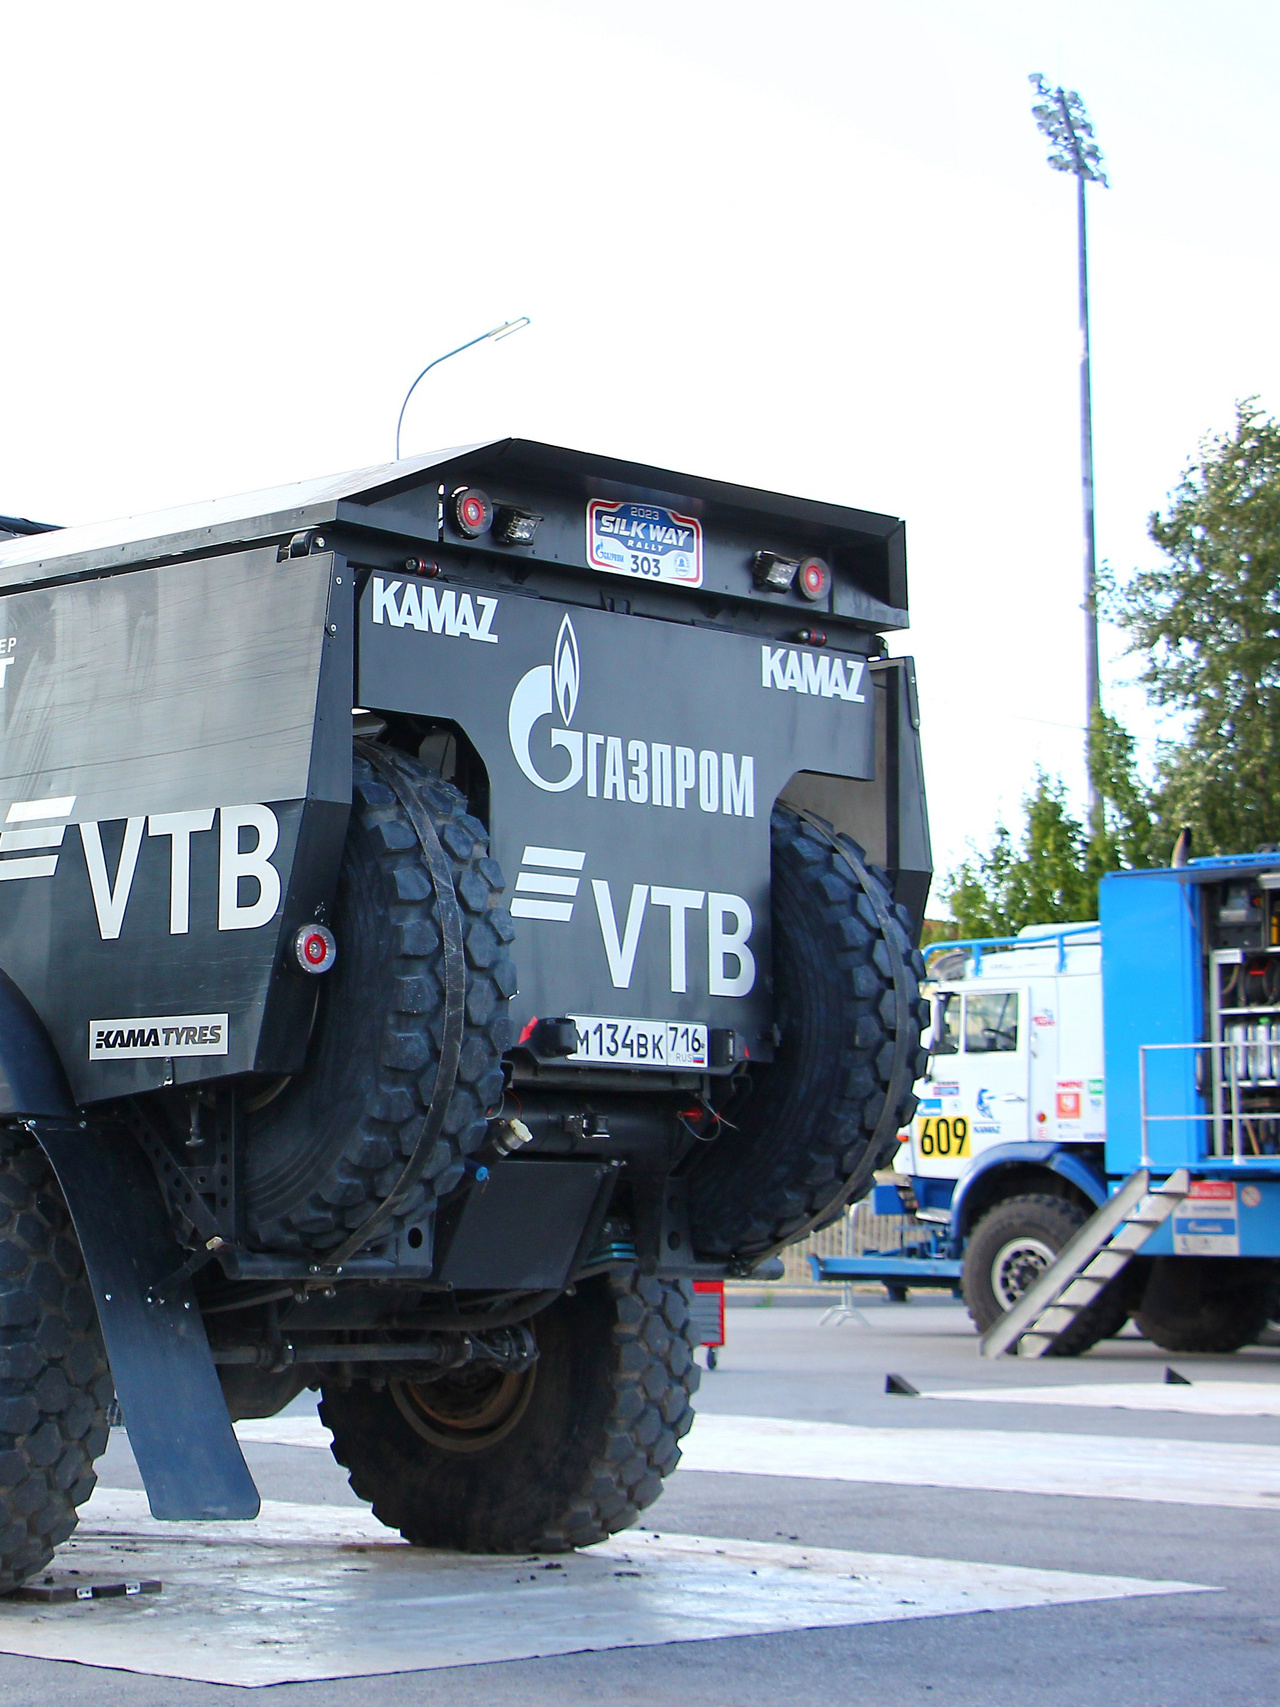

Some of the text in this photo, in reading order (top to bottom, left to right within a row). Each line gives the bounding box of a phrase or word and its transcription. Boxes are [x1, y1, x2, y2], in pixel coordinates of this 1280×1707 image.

[631, 506, 660, 520] 2023
[600, 515, 691, 547] SILK WAY
[627, 539, 664, 552] RALLY
[630, 554, 661, 578] 303
[372, 576, 499, 644] KAMAZ
[761, 645, 866, 703] KAMAZ
[587, 733, 755, 818] ГАЗПРОМ
[79, 803, 282, 941] VTB
[591, 879, 756, 998] VTB
[162, 1025, 222, 1046] TYRES
[669, 1026, 702, 1053] 716
[675, 1052, 693, 1063] RUS
[921, 1118, 966, 1155] 609
